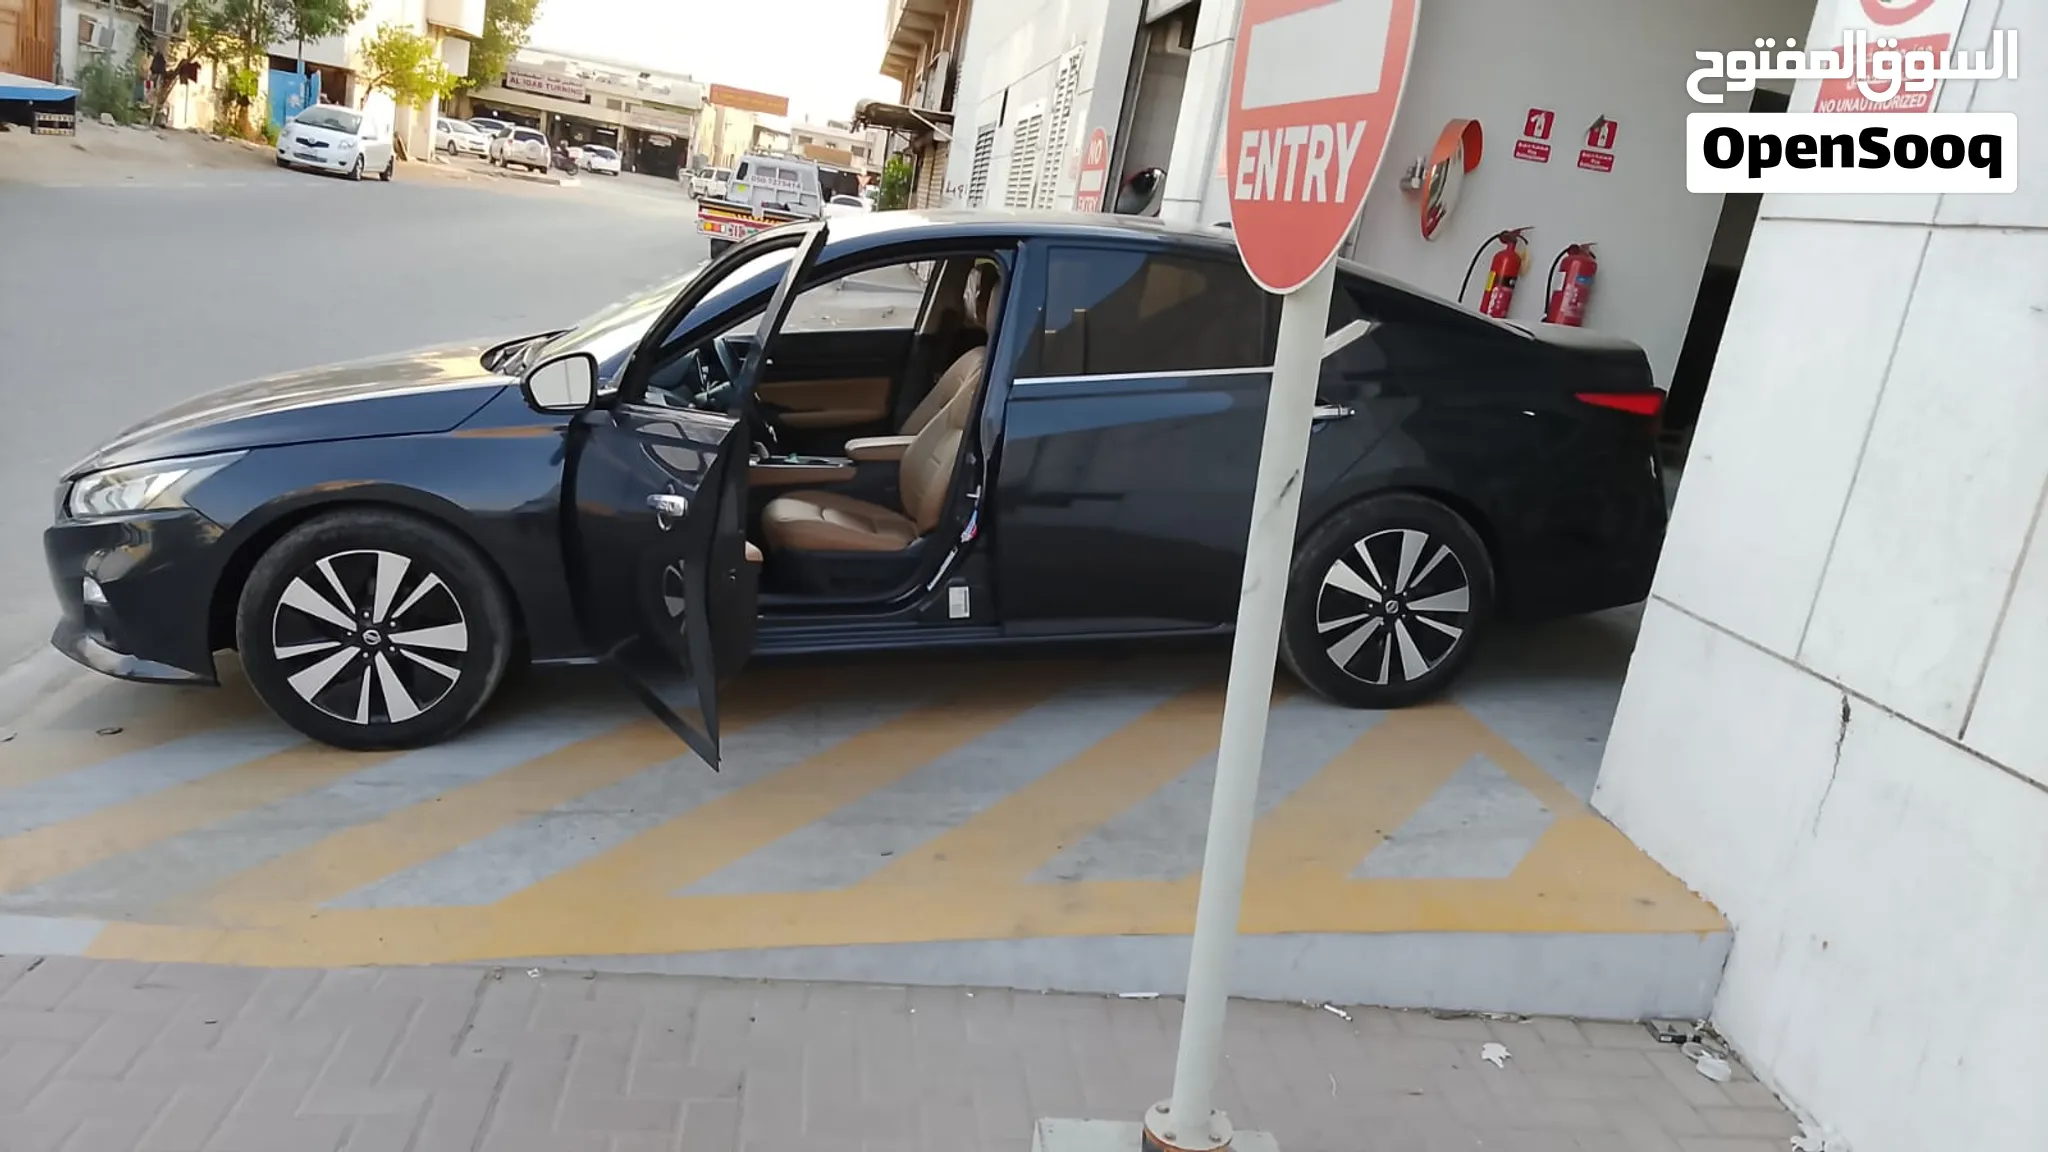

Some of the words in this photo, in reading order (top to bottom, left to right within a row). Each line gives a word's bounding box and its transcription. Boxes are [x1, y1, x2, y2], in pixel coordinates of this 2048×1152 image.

[1819, 98, 1836, 113] NO
[1836, 94, 1928, 112] UNAUTHORIZED
[1087, 139, 1103, 165] NO
[1234, 120, 1368, 203] ENTRY
